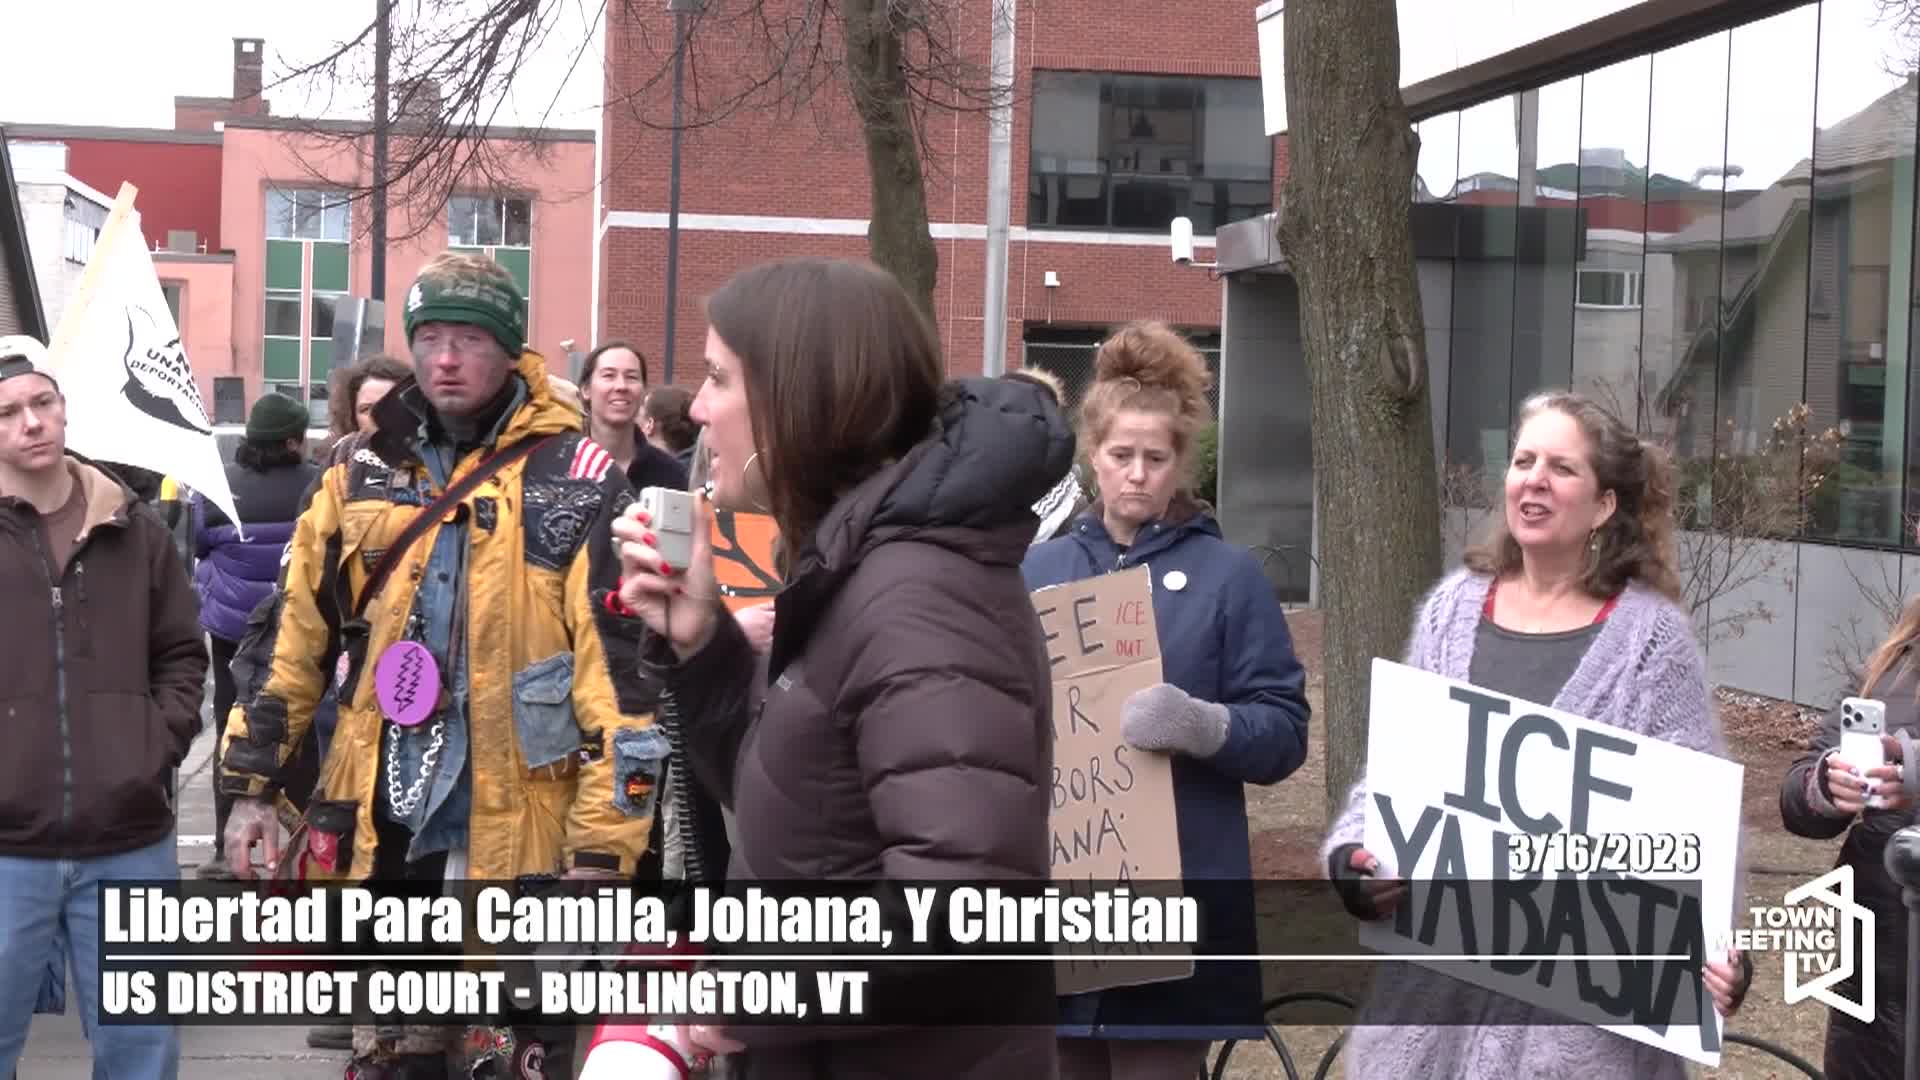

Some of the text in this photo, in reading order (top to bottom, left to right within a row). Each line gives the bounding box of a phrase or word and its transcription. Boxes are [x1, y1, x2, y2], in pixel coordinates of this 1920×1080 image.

[146, 348, 181, 377] UNA
[1115, 600, 1145, 625] ICE
[1115, 638, 1145, 657] OUT
[1372, 792, 1479, 963] YA
[1492, 829, 1721, 1053] BASTA
